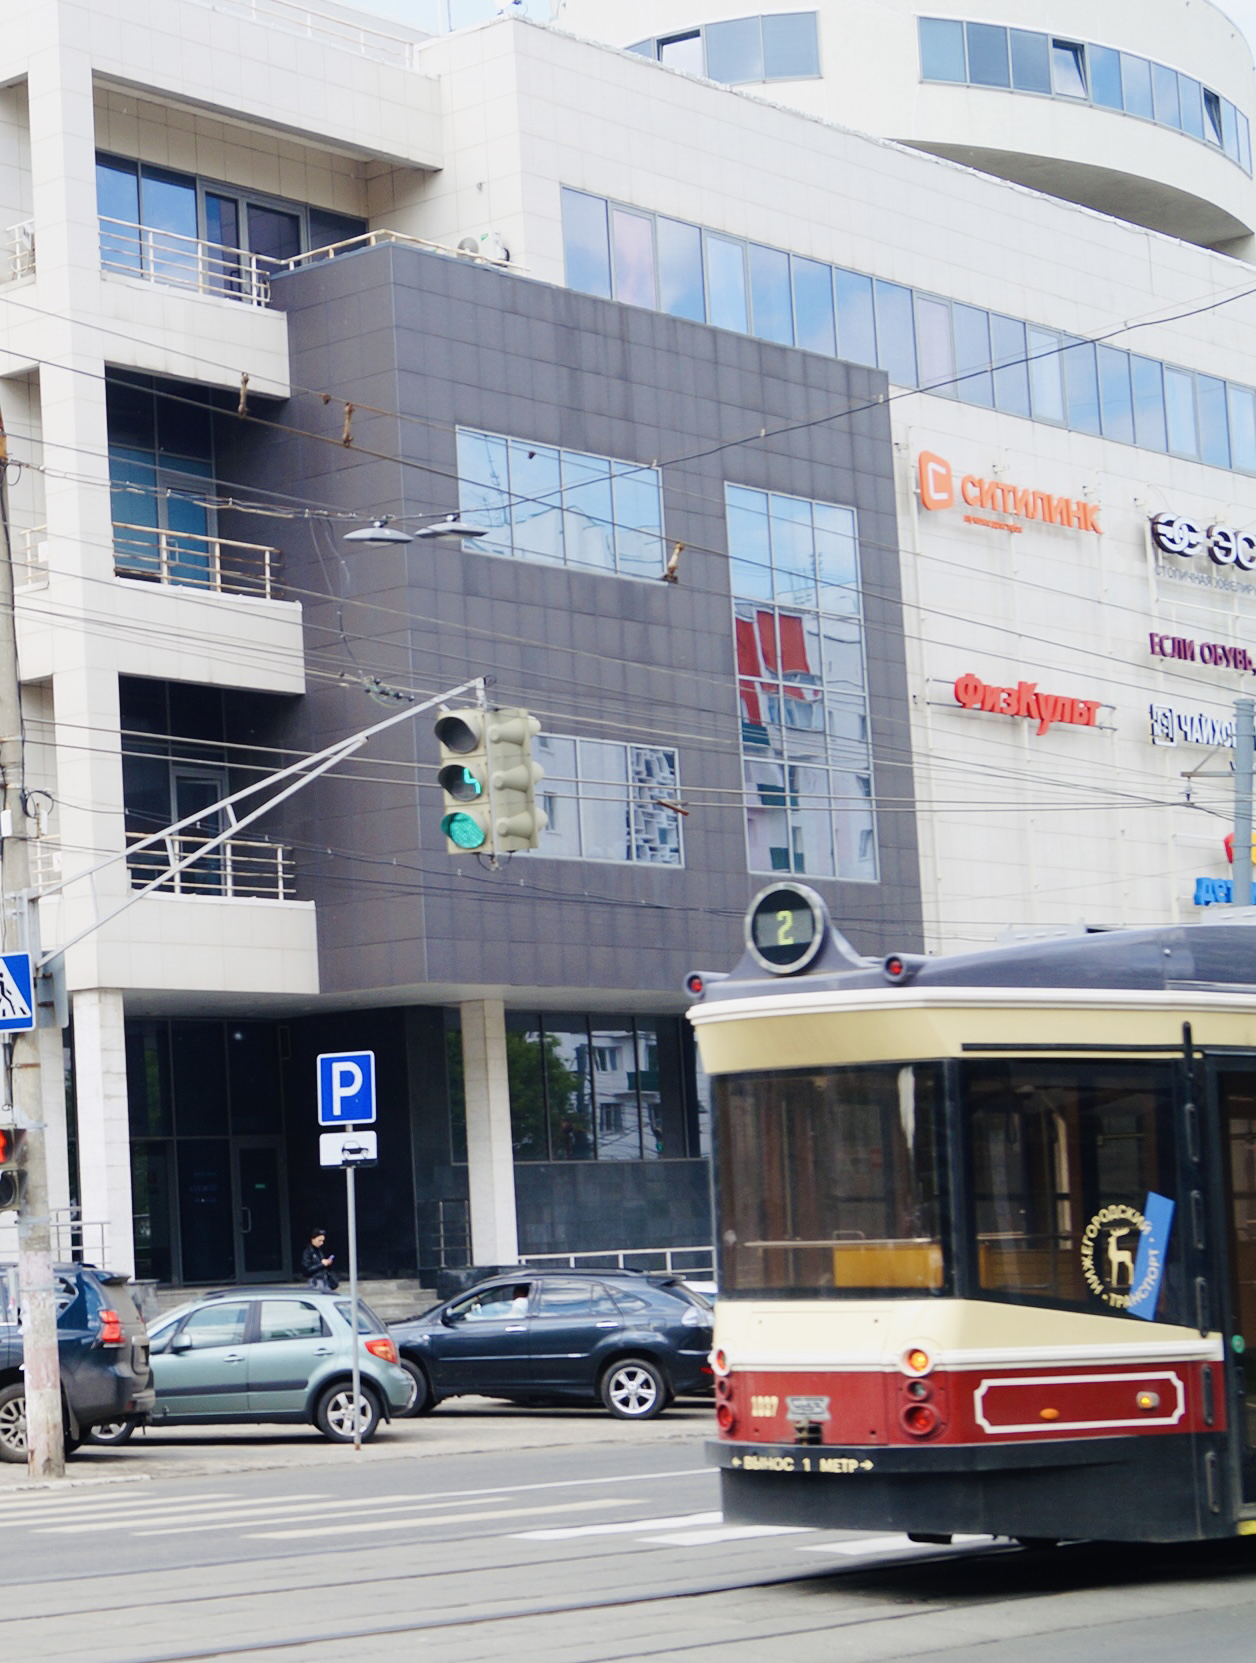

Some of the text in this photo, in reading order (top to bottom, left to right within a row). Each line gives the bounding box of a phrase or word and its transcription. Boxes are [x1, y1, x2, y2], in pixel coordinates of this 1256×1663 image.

[961, 474, 1104, 535] СИТИЛИНК
[1149, 632, 1196, 662] ЕСЛИ
[954, 673, 1102, 736] ФизКульт
[776, 909, 795, 946] 2
[331, 1061, 363, 1116] P
[742, 1455, 859, 1473] ВЫНОС 1 МЕТР
